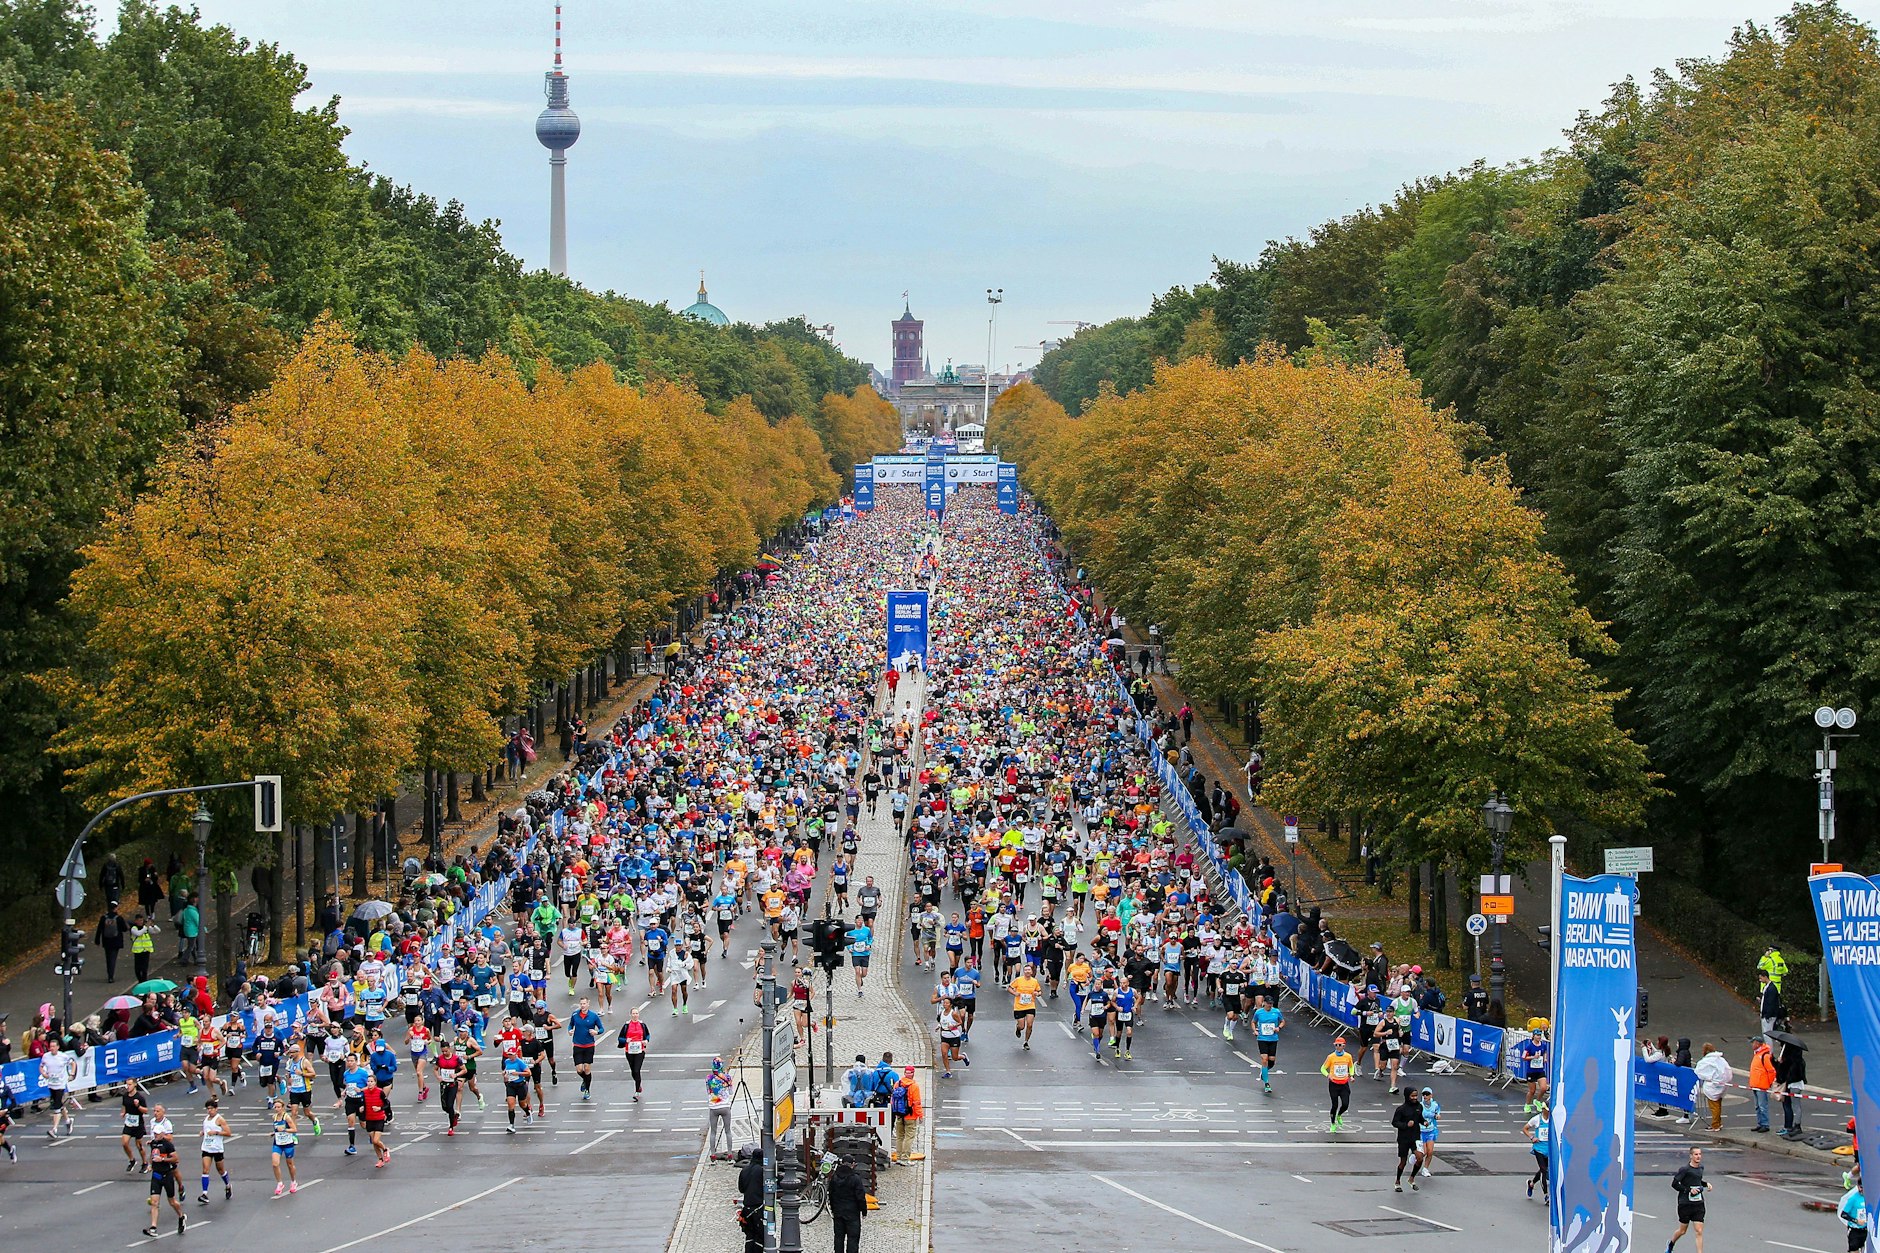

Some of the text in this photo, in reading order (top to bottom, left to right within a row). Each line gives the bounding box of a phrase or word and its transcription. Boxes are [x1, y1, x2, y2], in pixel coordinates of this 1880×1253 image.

[901, 469, 922, 478] Start
[972, 469, 993, 477] Start
[1568, 892, 1604, 920] BMW
[1565, 923, 1603, 944] BERLIN
